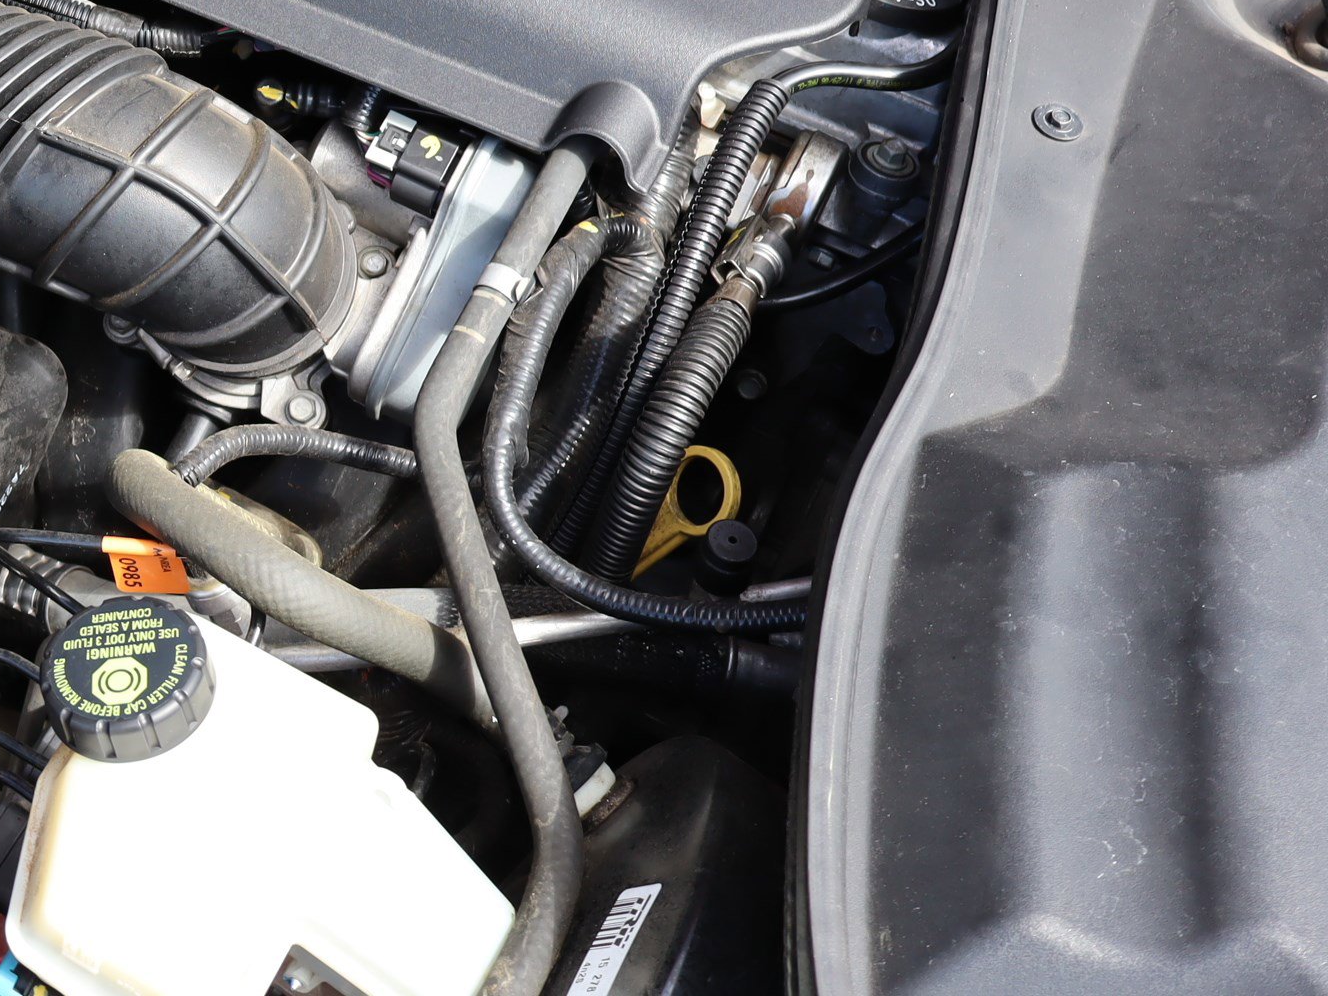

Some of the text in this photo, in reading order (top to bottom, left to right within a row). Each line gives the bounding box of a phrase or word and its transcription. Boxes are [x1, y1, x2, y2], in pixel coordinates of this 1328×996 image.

[119, 558, 142, 587] 0985
[92, 607, 152, 623] CONTAINER
[79, 618, 163, 637] FROM A SEALED
[63, 628, 180, 650] USE ONLY DOT 3 FLUID
[86, 642, 156, 661] WARNING!
[54, 643, 188, 717] CLEAN FILLER CAP BEFORE REMOVING
